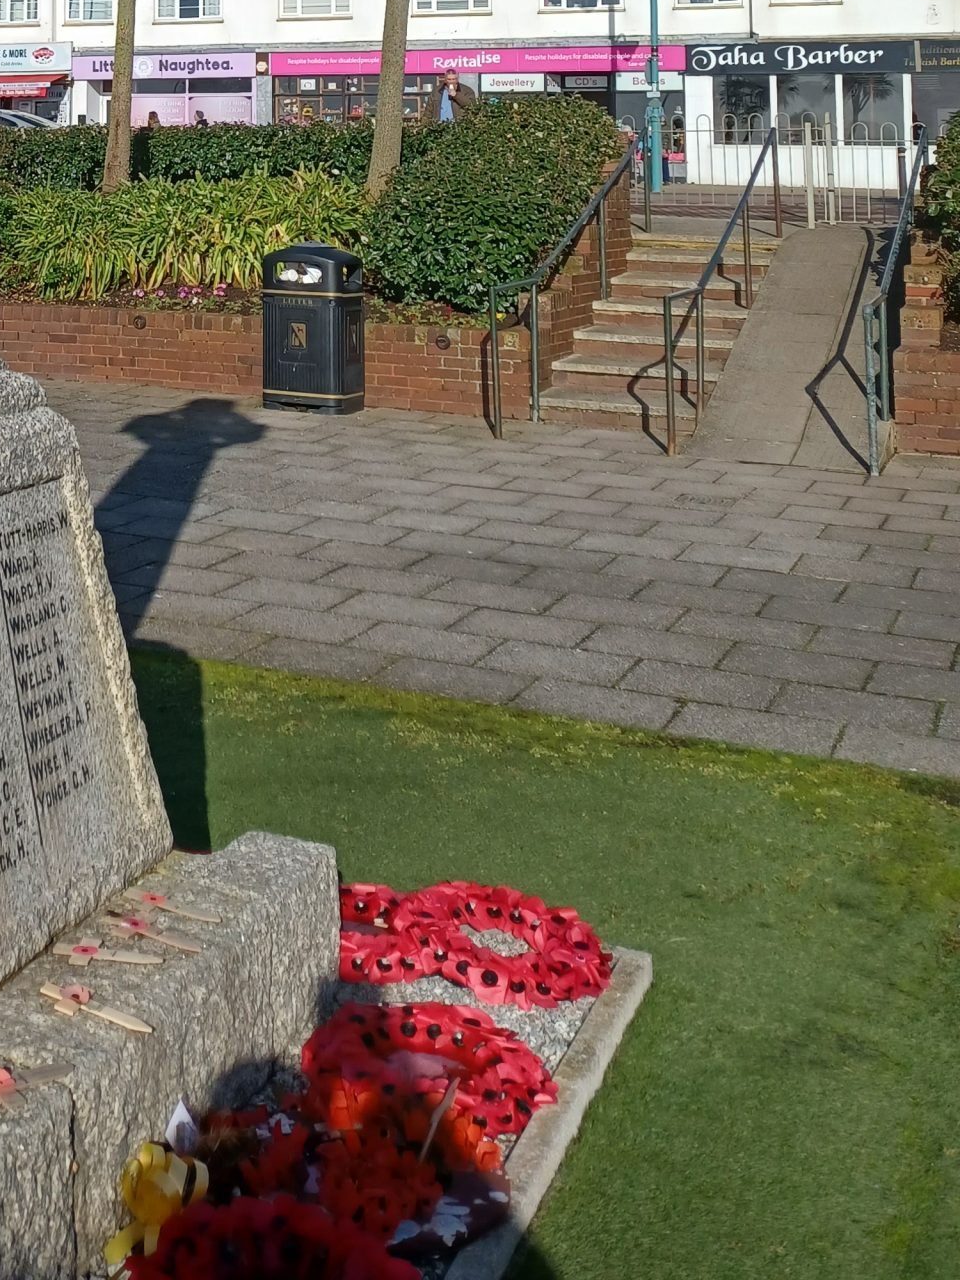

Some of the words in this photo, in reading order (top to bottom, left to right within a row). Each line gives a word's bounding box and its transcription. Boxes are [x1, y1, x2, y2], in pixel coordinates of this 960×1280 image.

[2, 49, 7, 58] &
[9, 49, 27, 58] MORE
[547, 52, 572, 61] holidays
[573, 52, 581, 60] for
[582, 52, 607, 60] disabled
[609, 51, 630, 60] people
[774, 44, 883, 70] Barber
[307, 57, 329, 65] holidays
[433, 52, 500, 69] Revitalise
[93, 60, 115, 73] Litt
[490, 78, 535, 87] Jewellery
[575, 78, 597, 86] CD's
[633, 77, 665, 85] Bos
[14, 636, 51, 665] WELLS,
[18, 664, 57, 694] WELLS,
